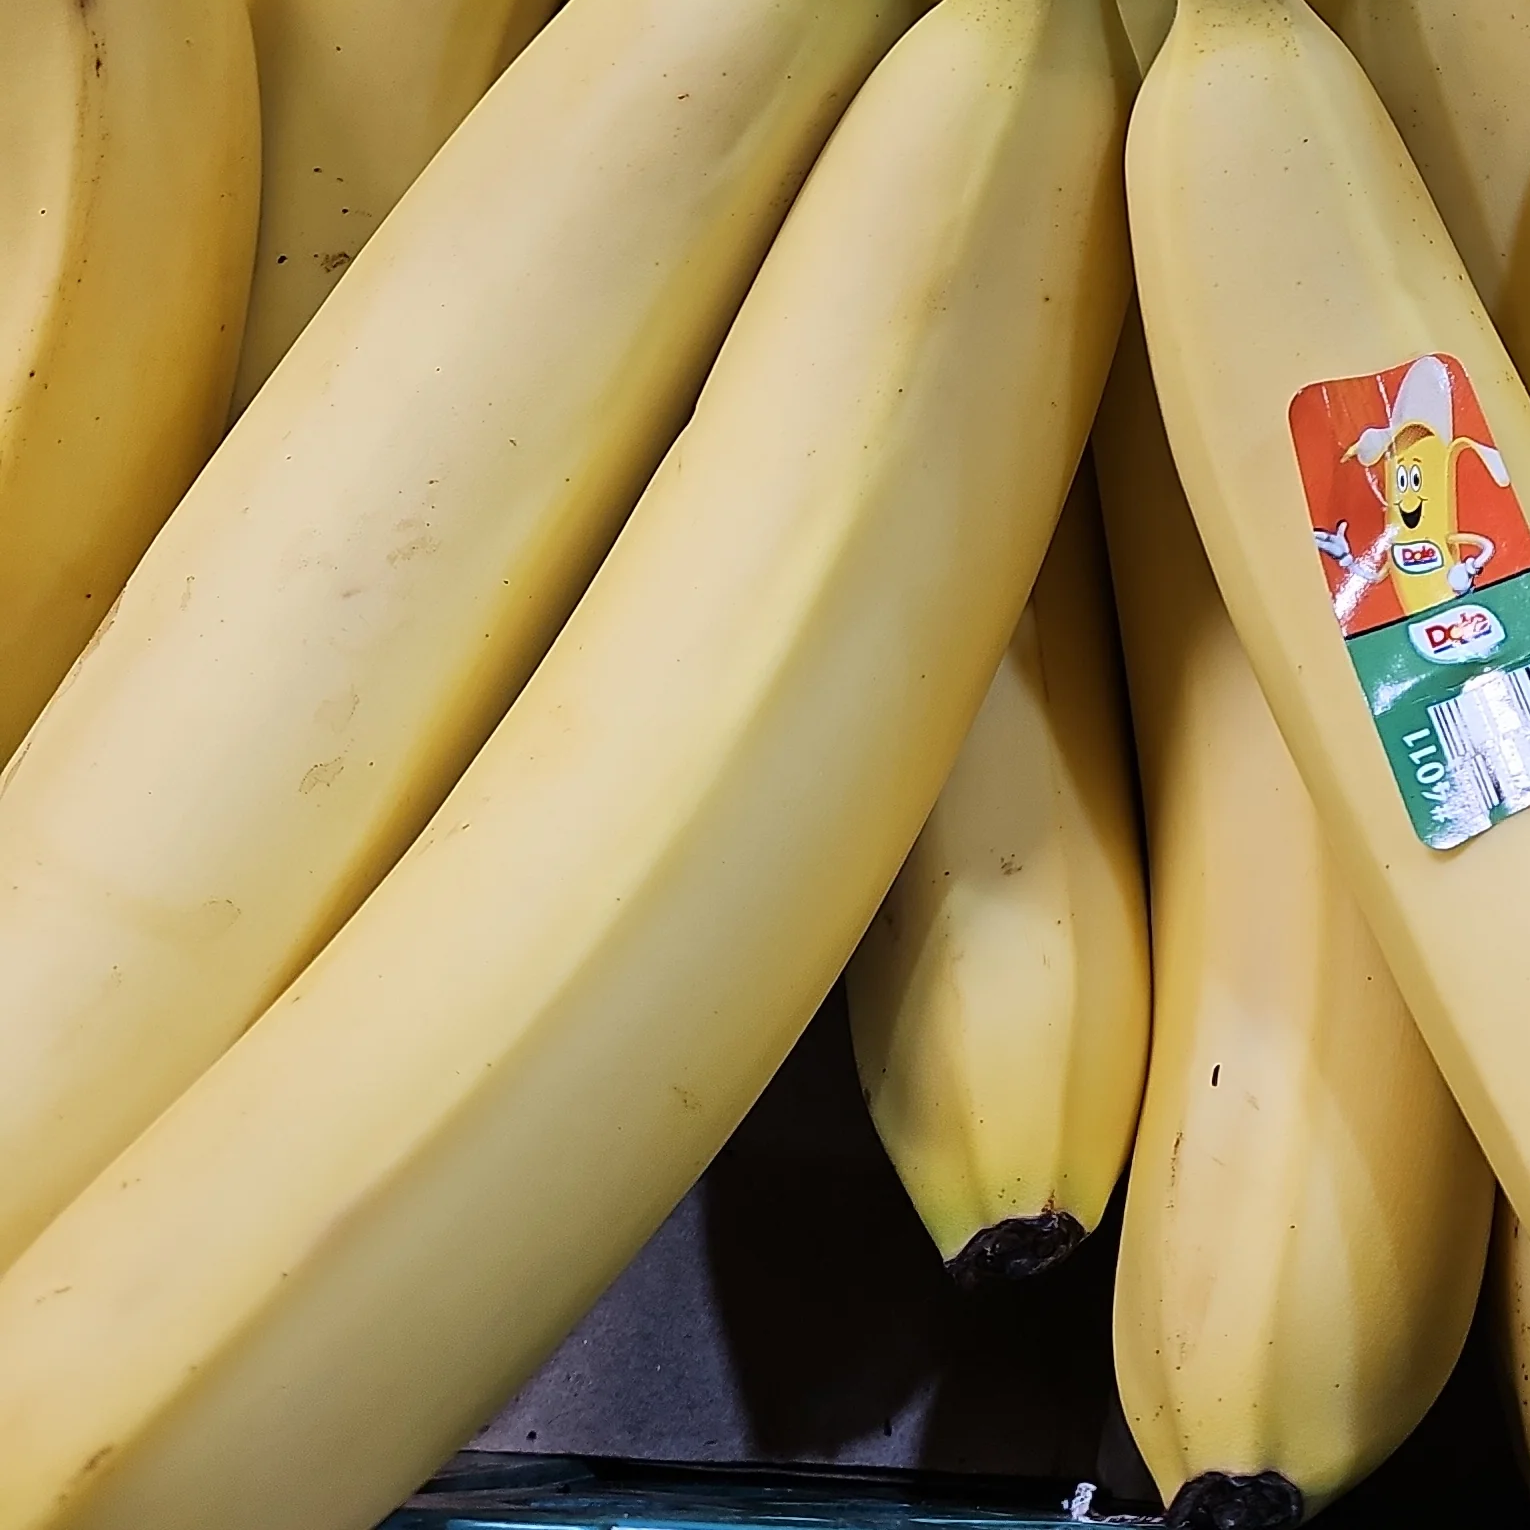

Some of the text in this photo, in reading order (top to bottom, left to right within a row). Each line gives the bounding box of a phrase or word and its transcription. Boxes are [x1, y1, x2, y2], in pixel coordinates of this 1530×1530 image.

[1401, 546, 1436, 563] Dole
[1424, 612, 1490, 649] Dole
[1402, 728, 1451, 823] #4011
